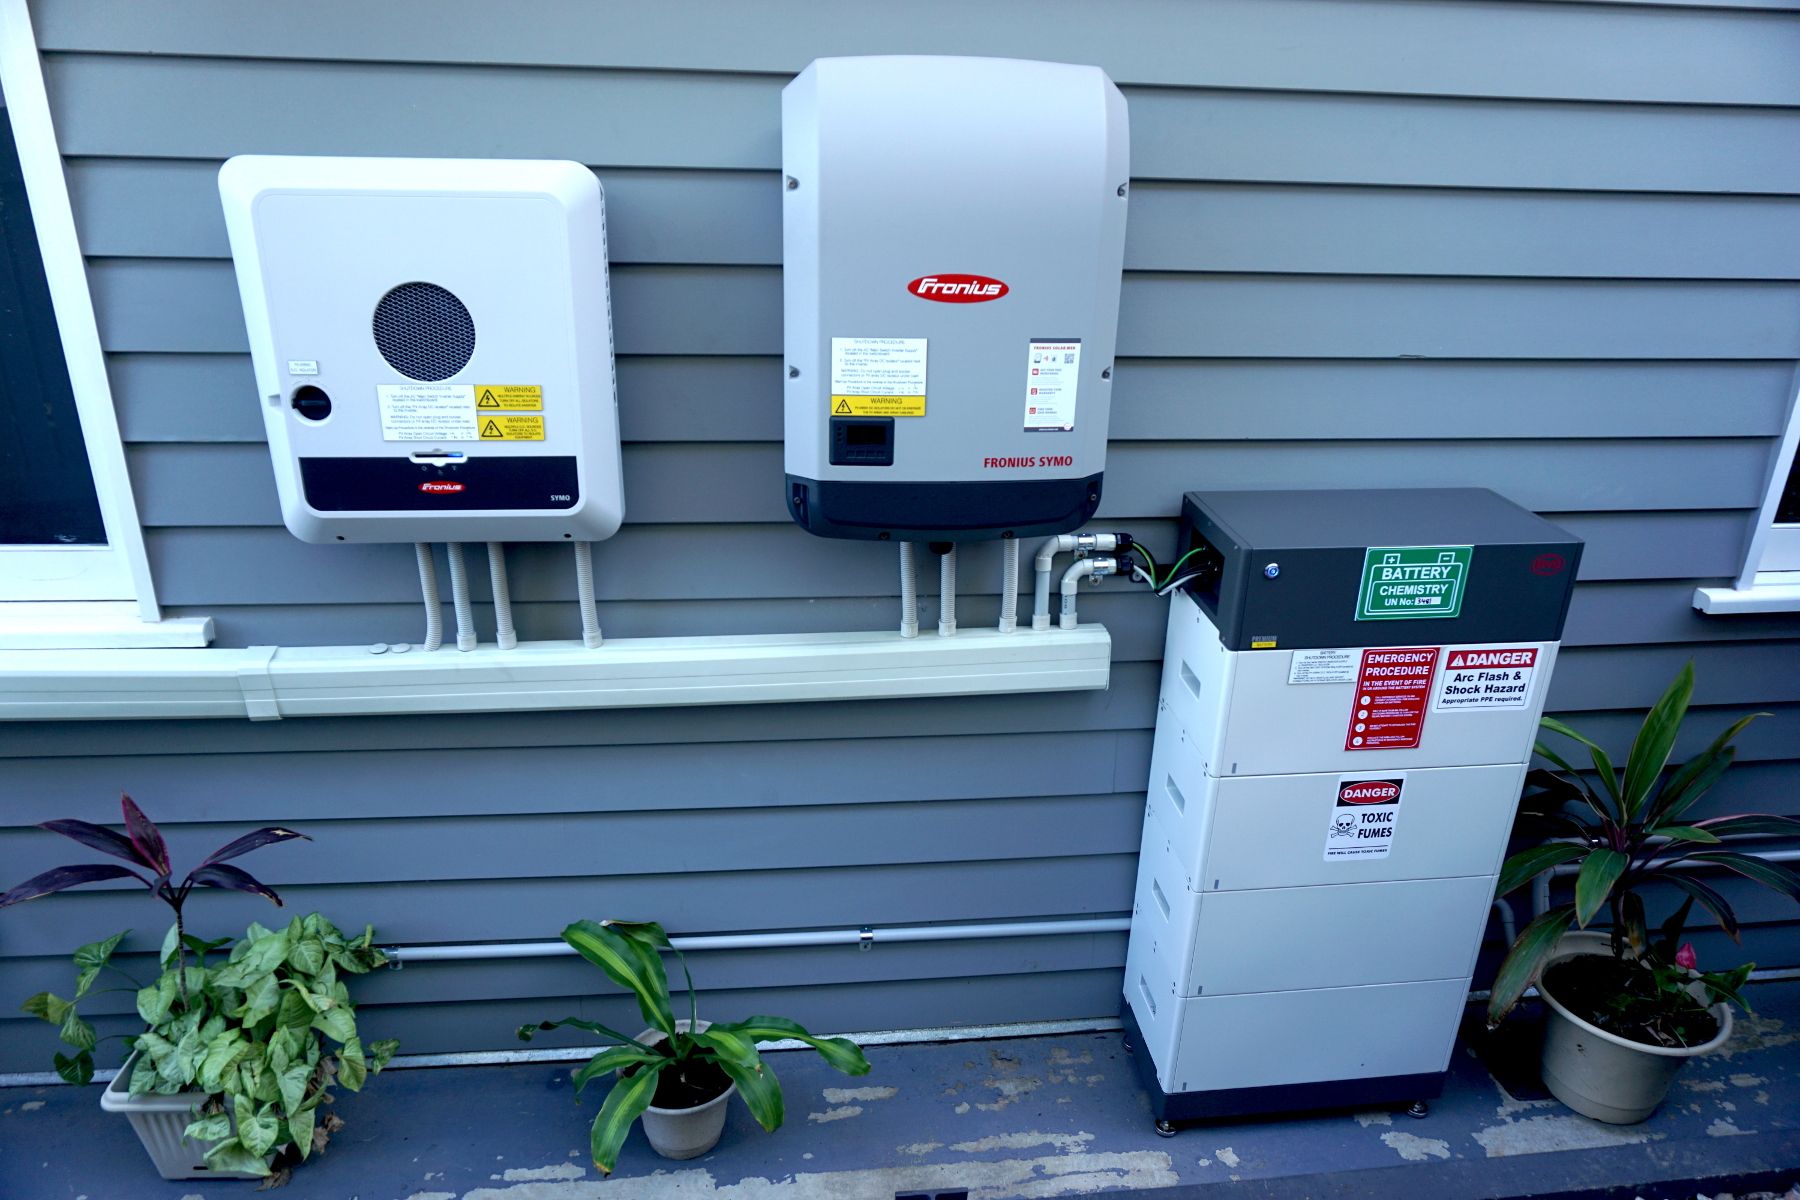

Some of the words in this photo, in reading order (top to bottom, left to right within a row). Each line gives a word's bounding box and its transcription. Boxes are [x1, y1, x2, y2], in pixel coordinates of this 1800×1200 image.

[917, 278, 1002, 295] Fronius
[984, 457, 1035, 468] FRONIUS
[1039, 456, 1072, 467] SYMO
[422, 483, 462, 491] Fronius
[1381, 566, 1452, 580] BATTERY
[1379, 584, 1449, 595] CHEMISTRY
[1385, 598, 1398, 606] UN
[1367, 653, 1434, 664] EMERGENCY
[1466, 652, 1533, 665] DANGER
[1365, 666, 1430, 677] PROCEDURE
[1453, 673, 1474, 682] Arc
[1478, 672, 1509, 681] Flash
[1513, 671, 1521, 680] &
[1445, 685, 1481, 694] Shock
[1484, 683, 1525, 693] Hazard
[1441, 697, 1479, 705] Appropriate
[1344, 788, 1395, 798] DANGER
[1361, 812, 1394, 823] TOXIC
[1357, 827, 1392, 839] FUMES
